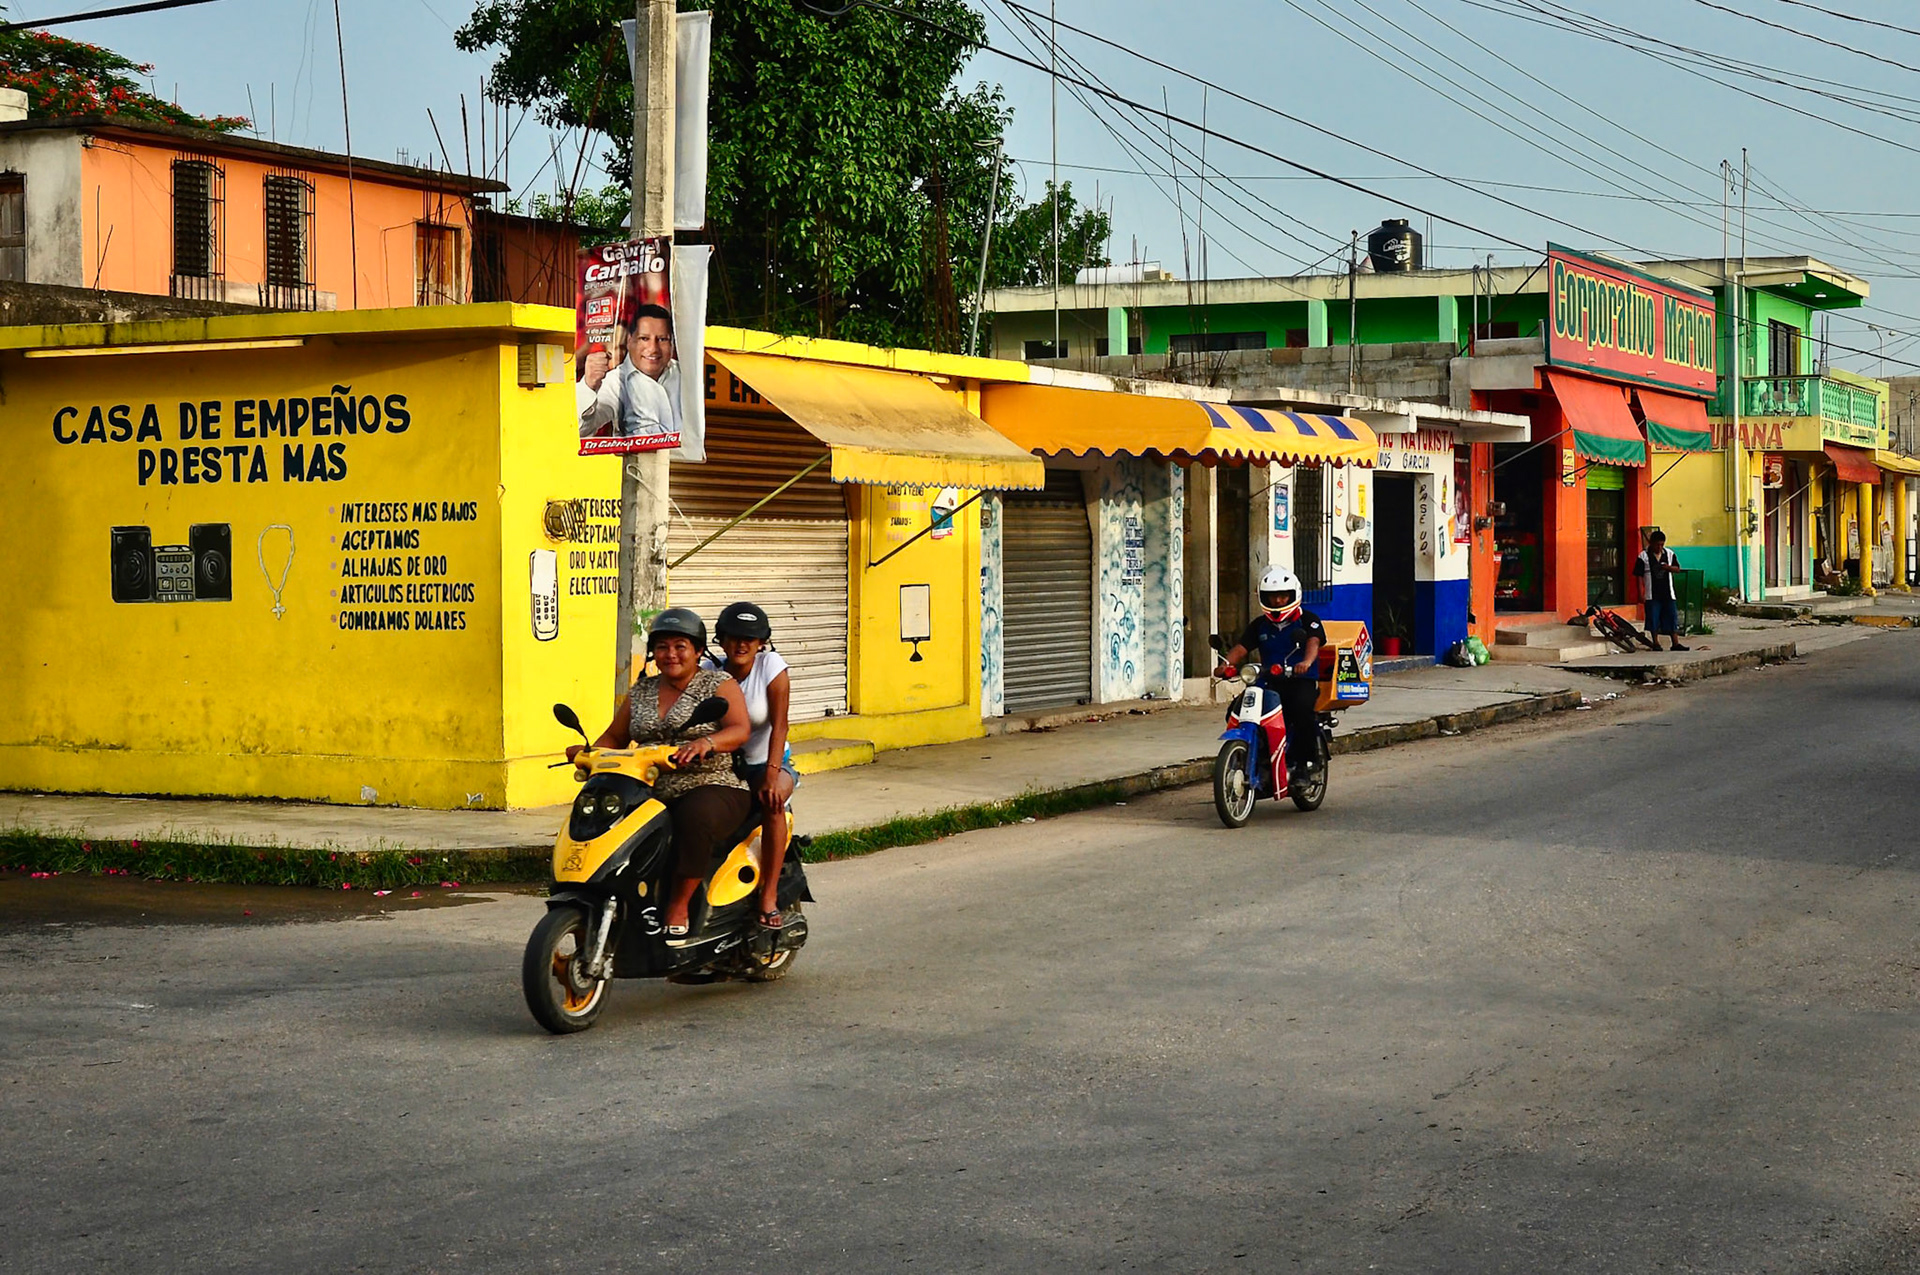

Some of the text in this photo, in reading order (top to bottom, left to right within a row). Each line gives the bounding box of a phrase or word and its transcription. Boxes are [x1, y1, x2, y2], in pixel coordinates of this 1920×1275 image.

[585, 255, 665, 282] Carballo
[1553, 259, 1656, 359] Corporativo
[589, 335, 611, 343] VOTA
[53, 384, 412, 444] CASA DE EMPEÑOS
[1401, 429, 1455, 452] NATURISTA
[138, 442, 347, 486] PRESTA MAS
[1402, 452, 1430, 469] GARCIA
[340, 501, 477, 523] INTERESES MAS BAJOS
[341, 529, 420, 551] ACEPTAMOS
[341, 555, 447, 577] ALHAJAS DE ORO
[569, 551, 586, 569] ORO
[597, 550, 620, 569] ARTI
[340, 582, 475, 603] ARTICULOS ELECTRICOS
[569, 576, 620, 595] ELECTRICO
[415, 611, 466, 631] DOLARES
